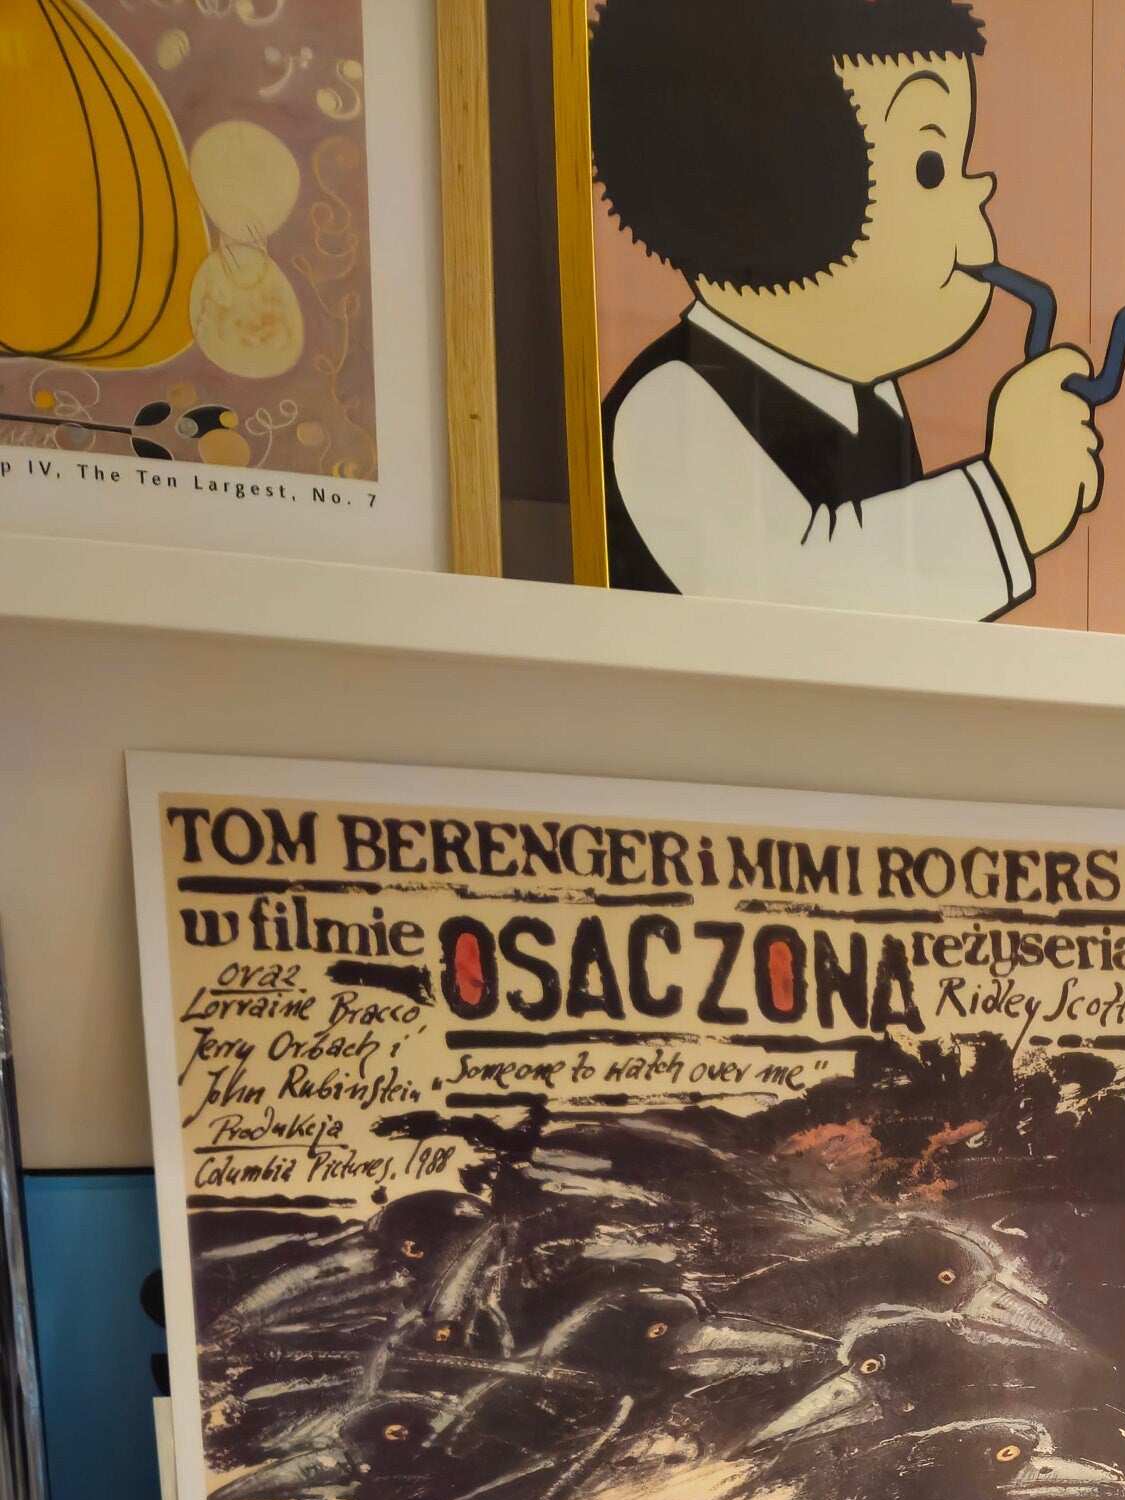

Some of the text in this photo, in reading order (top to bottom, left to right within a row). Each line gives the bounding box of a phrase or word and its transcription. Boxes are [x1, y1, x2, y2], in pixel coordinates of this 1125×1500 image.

[27, 459, 61, 479] IV,
[76, 463, 121, 483] The
[136, 469, 178, 489] Ten
[194, 475, 297, 501] Largest,
[312, 487, 352, 506] No.
[367, 493, 377, 508] 7
[167, 807, 1122, 904] TOM BERENGER i MIMI ROGERS
[179, 895, 425, 958] w filmie
[180, 986, 317, 1023] Lorraine
[438, 914, 926, 1034] OSACZONA
[935, 975, 1042, 1065] Ridley
[178, 1026, 256, 1087] Jerry
[267, 1030, 380, 1079] Orbach
[571, 1050, 596, 1083] to
[604, 1048, 685, 1084] watch
[689, 1061, 753, 1083] over
[182, 1063, 421, 1128] John Rubinstein
[194, 1154, 298, 1189] Columbia
[405, 1139, 457, 1180] 1988
